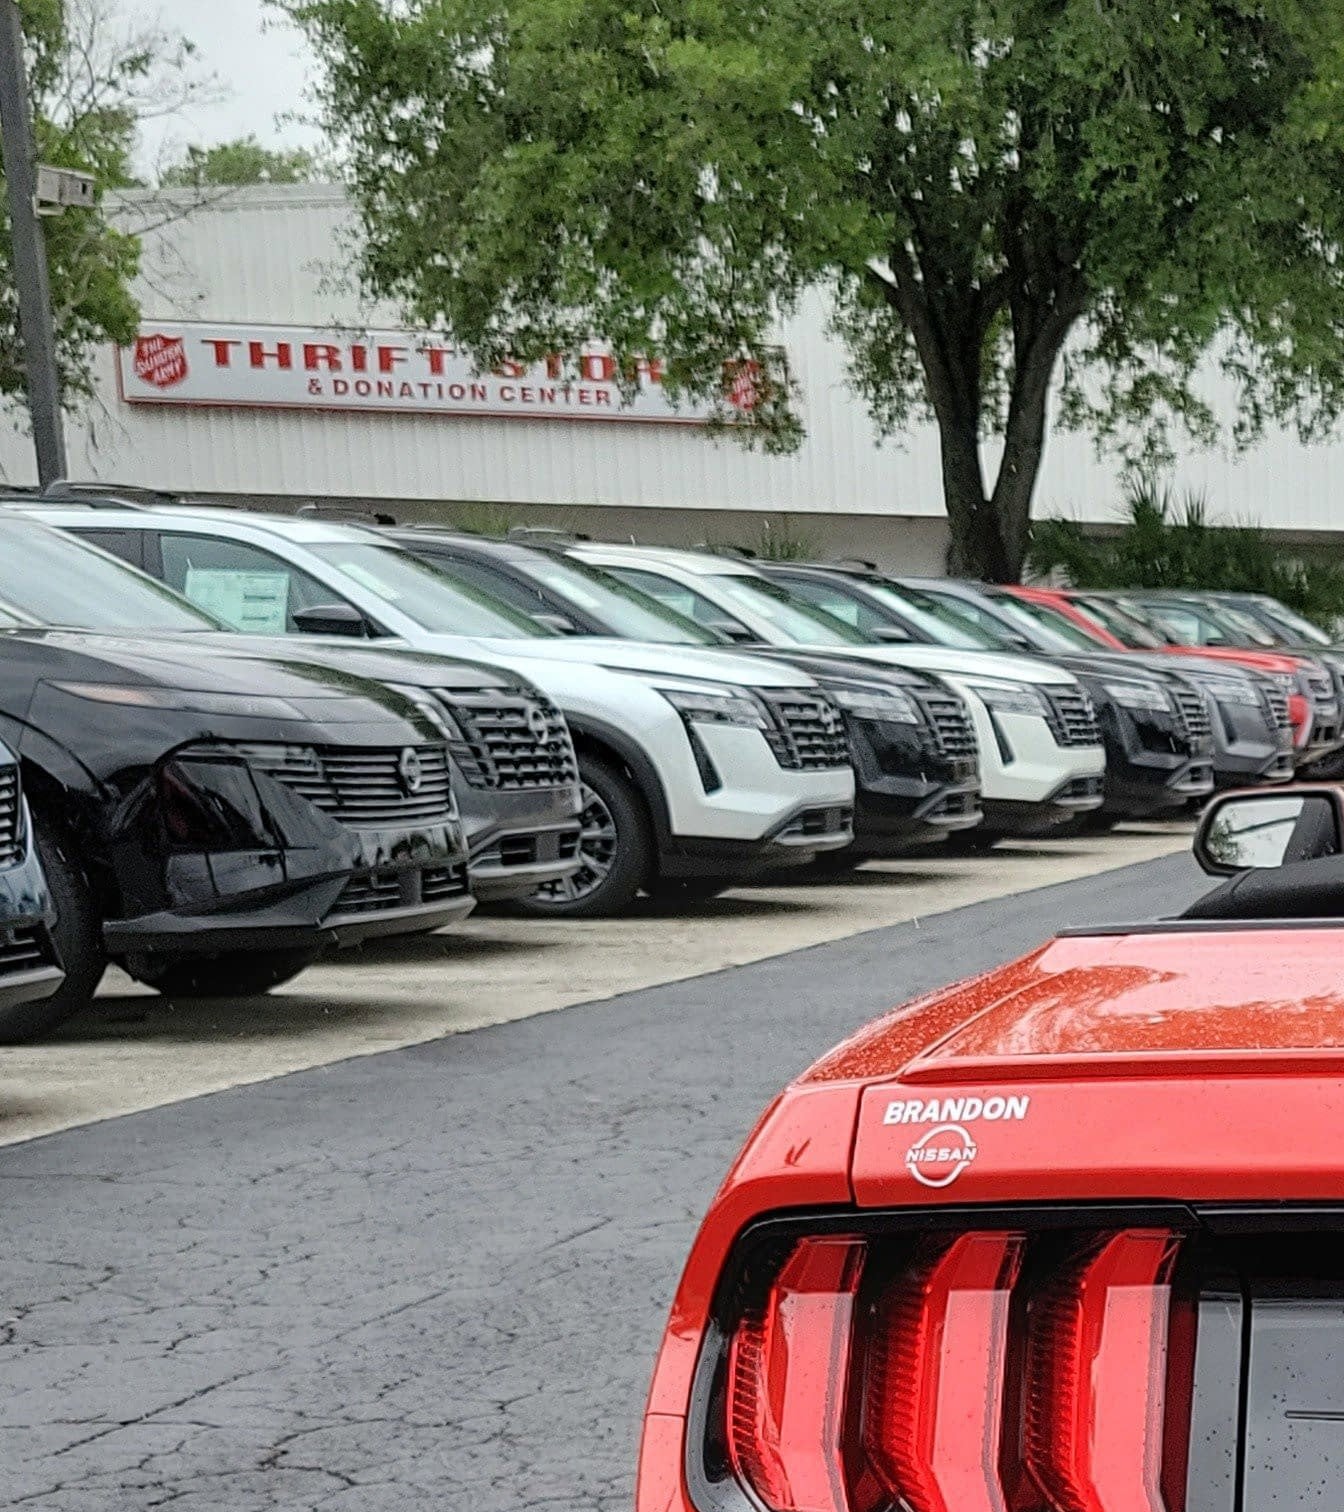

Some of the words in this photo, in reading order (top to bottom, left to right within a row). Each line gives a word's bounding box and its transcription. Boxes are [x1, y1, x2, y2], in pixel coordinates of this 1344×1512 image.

[201, 339, 454, 375] THRIFT
[307, 378, 322, 396] &
[333, 379, 488, 401] DONATION
[501, 385, 612, 406] CENTER
[883, 1095, 1030, 1124] BRANDON
[905, 1147, 977, 1163] NISSAN
